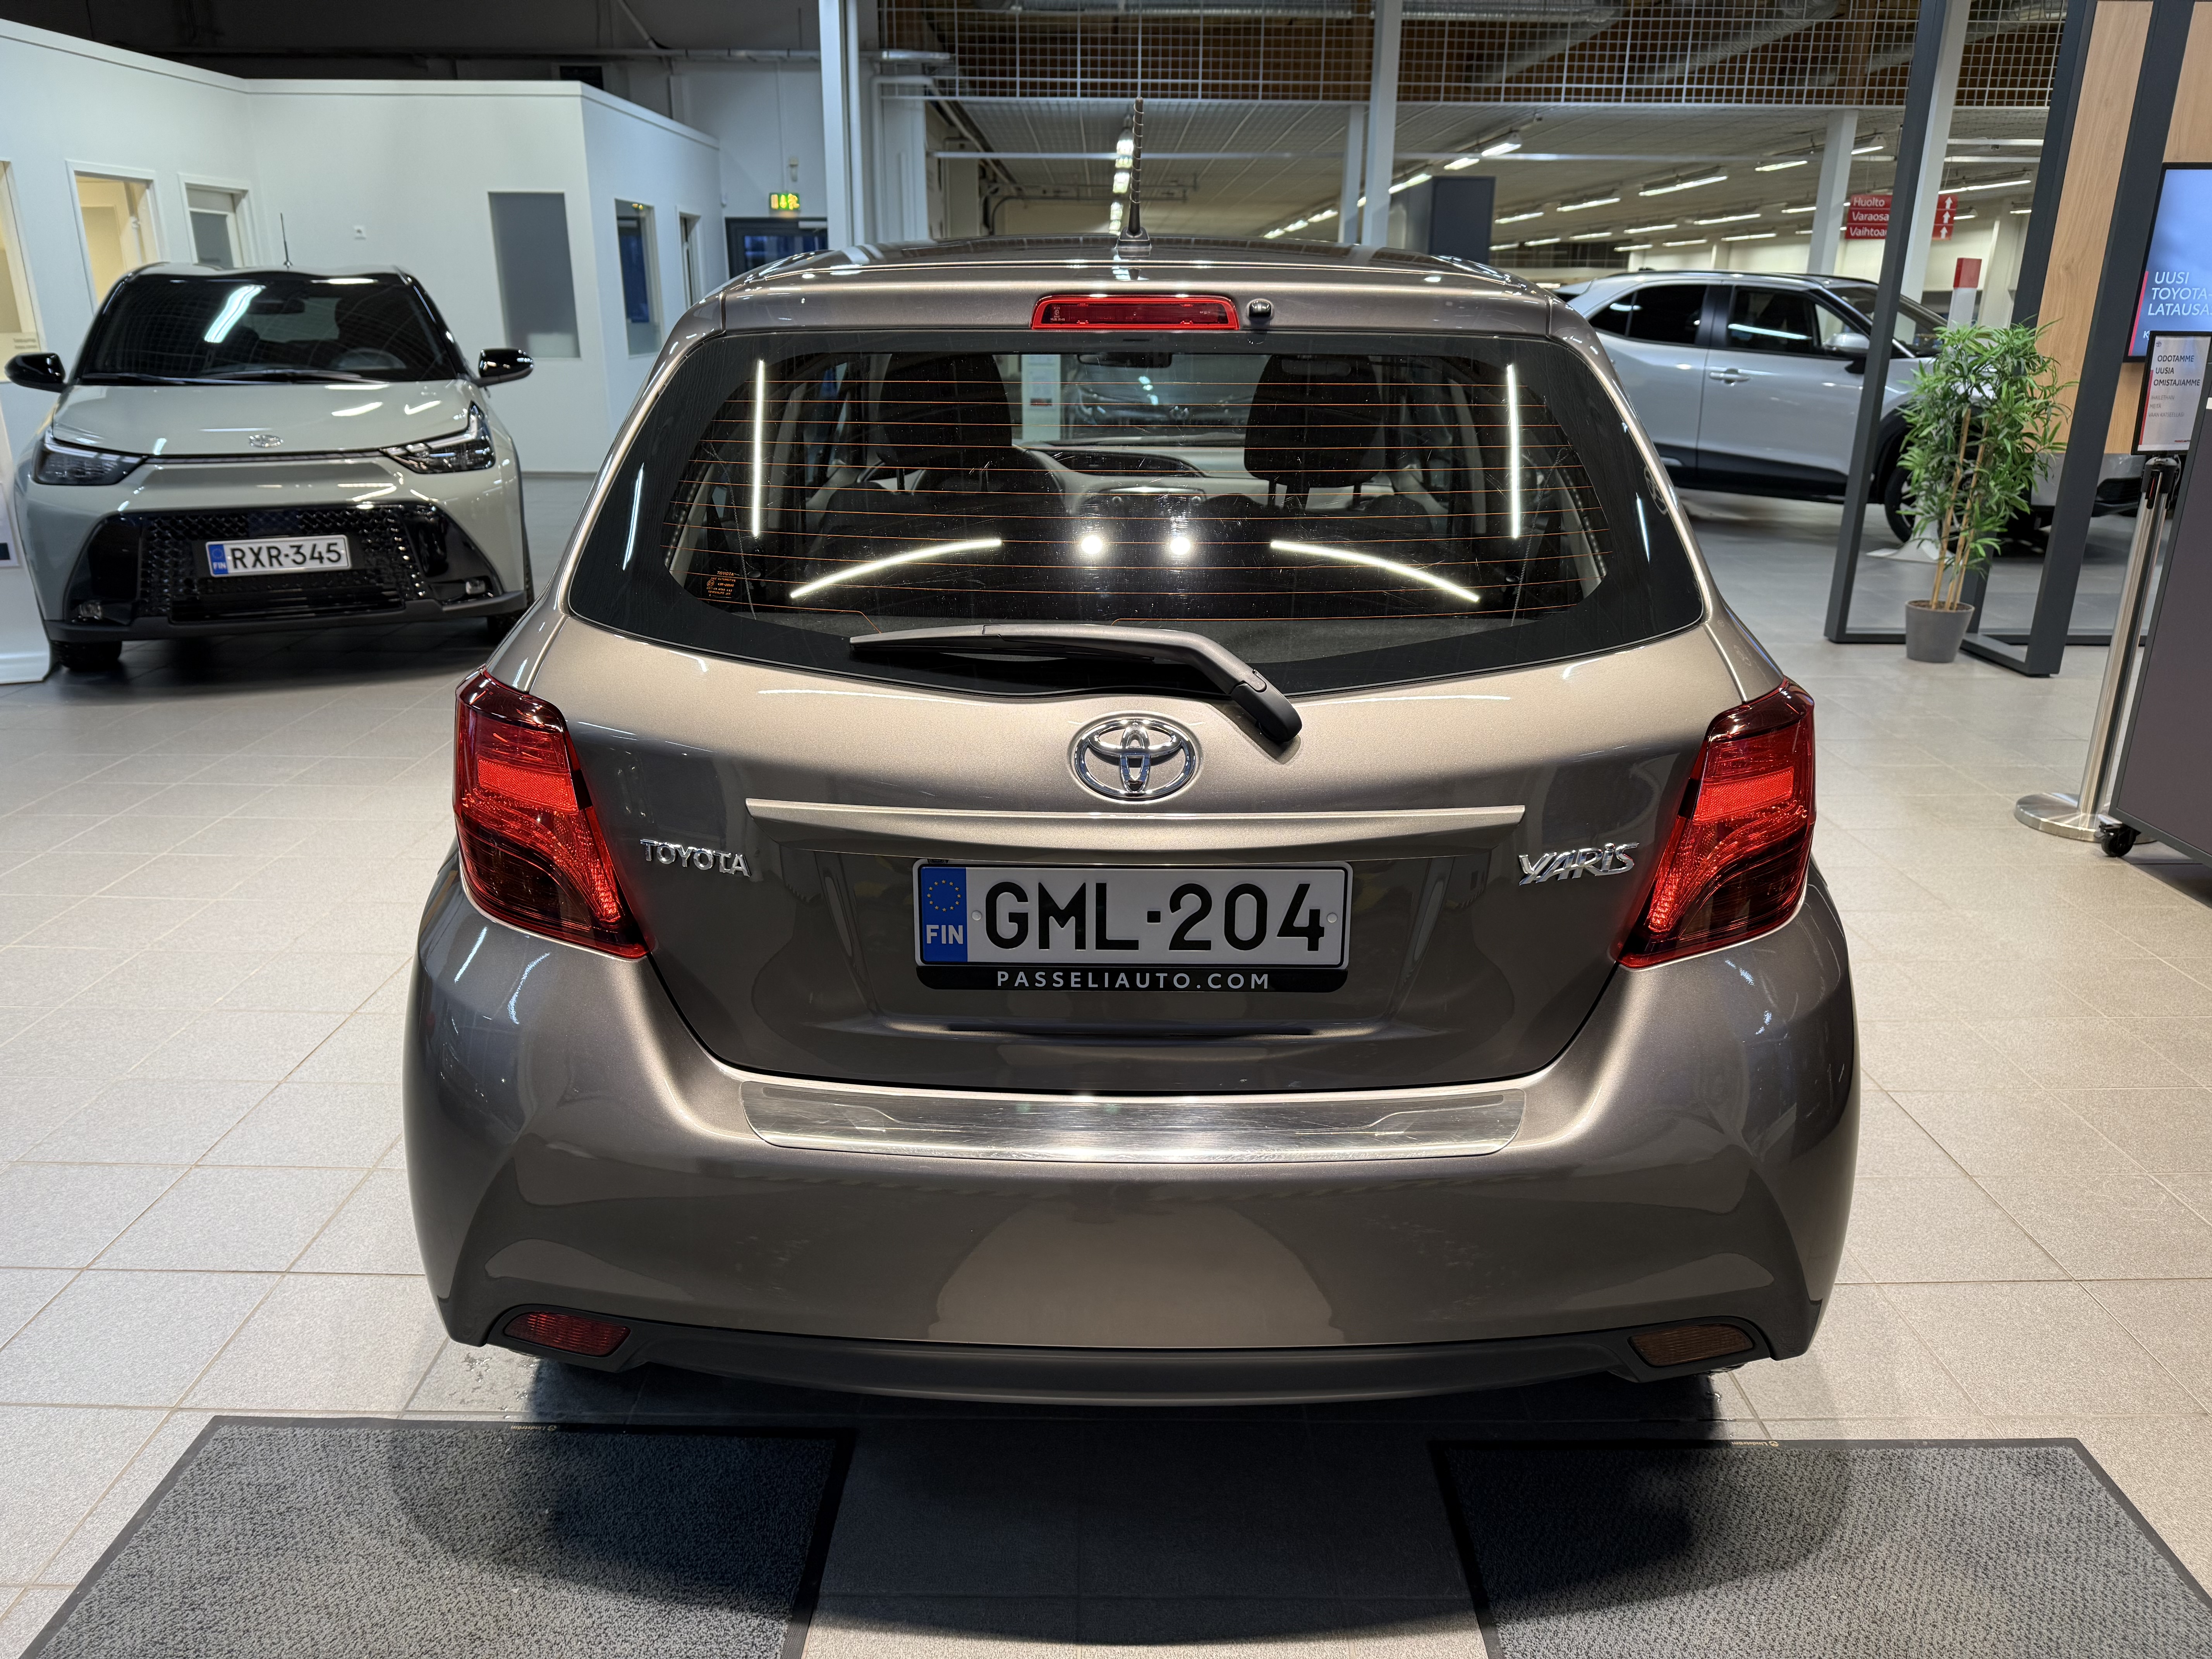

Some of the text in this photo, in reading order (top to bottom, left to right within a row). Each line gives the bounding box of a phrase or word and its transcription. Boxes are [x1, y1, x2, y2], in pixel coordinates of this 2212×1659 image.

[1853, 197, 1885, 207] Huolto
[2155, 271, 2190, 284] UUSI
[230, 543, 342, 568] RXR-345
[213, 562, 226, 570] FIN
[640, 839, 751, 877] TOYOTA
[986, 881, 1324, 951] GML-204
[926, 924, 963, 944] FIN
[997, 971, 1268, 989] PASSELIAUTO.COM
